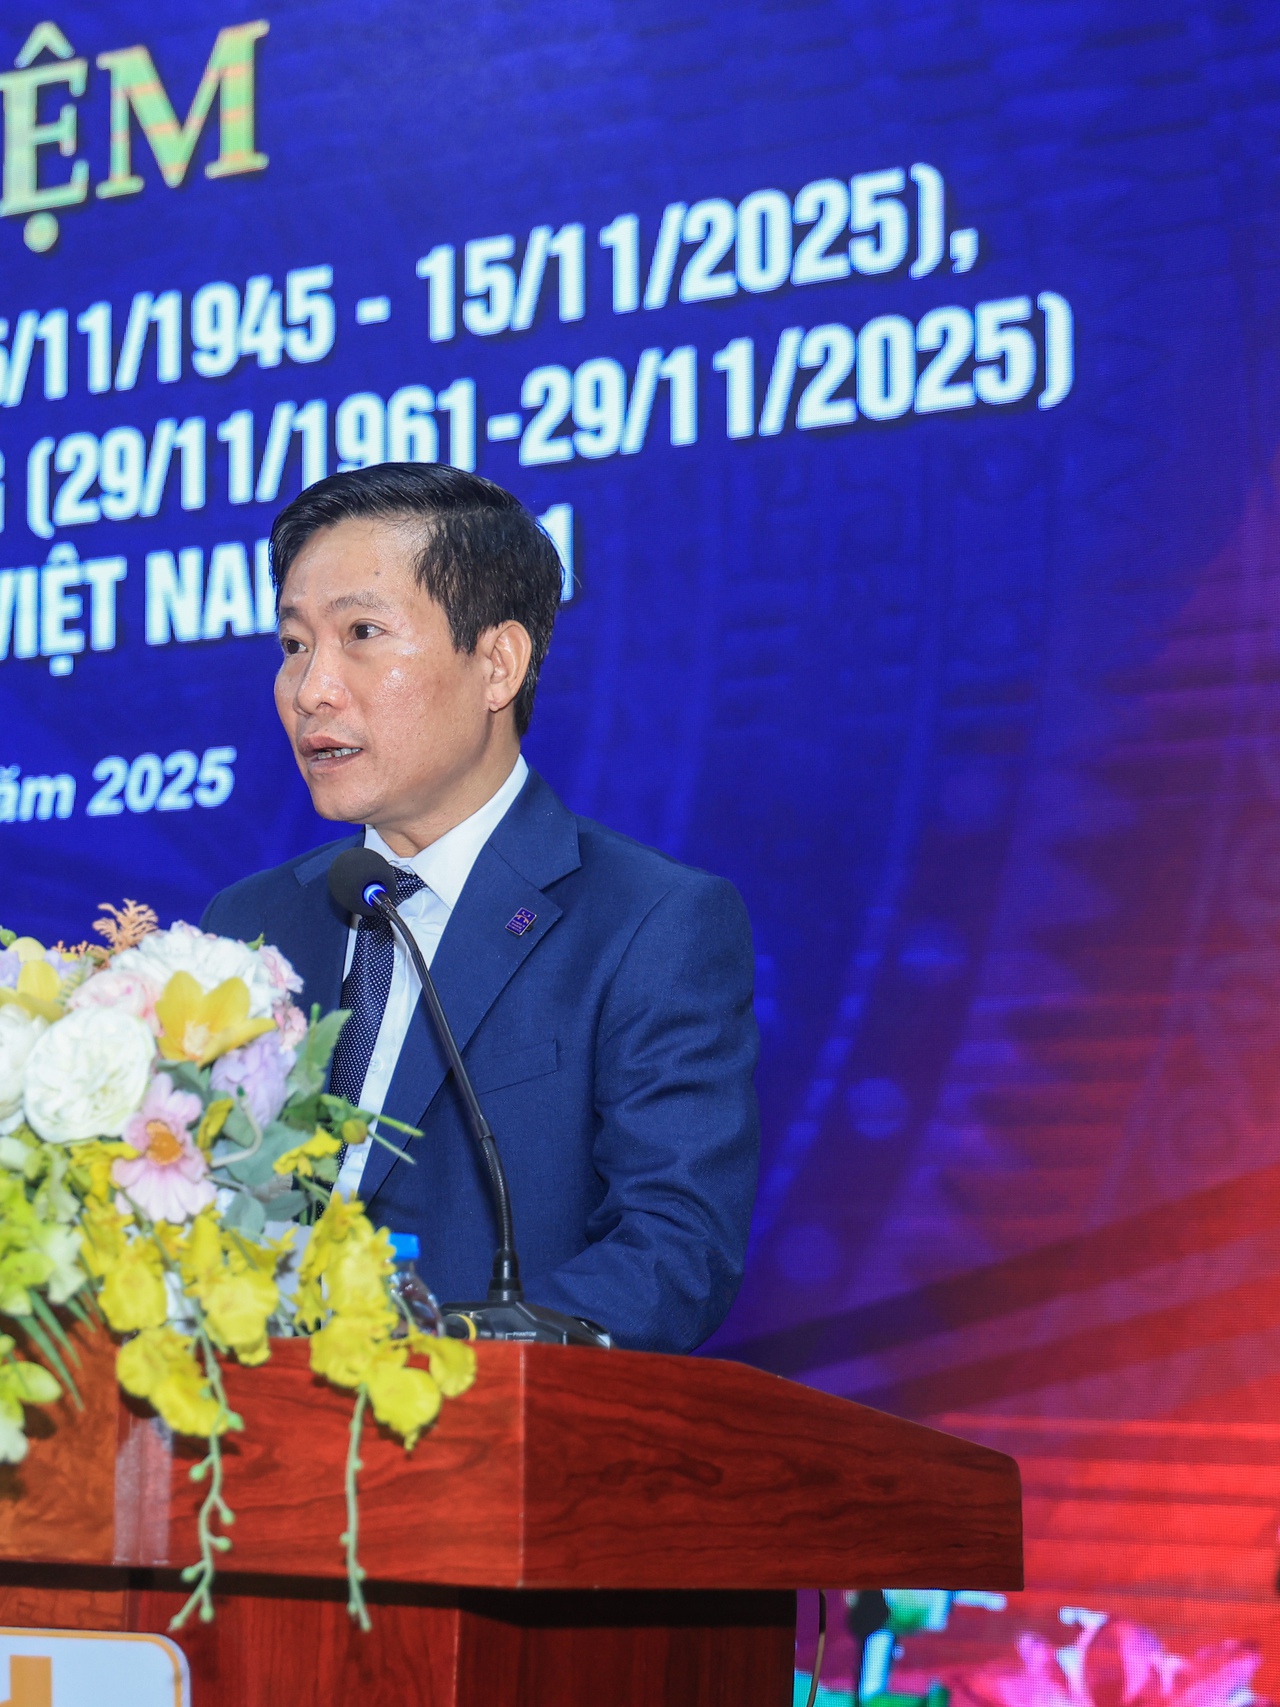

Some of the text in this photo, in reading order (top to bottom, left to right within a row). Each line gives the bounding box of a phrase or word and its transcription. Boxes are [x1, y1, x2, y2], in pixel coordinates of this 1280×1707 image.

[356, 297, 389, 325] -
[417, 162, 978, 342] 15/11/2025),
[26, 291, 1074, 539] (29/11/1961-29/11/2025)
[86, 745, 237, 817] 2025
